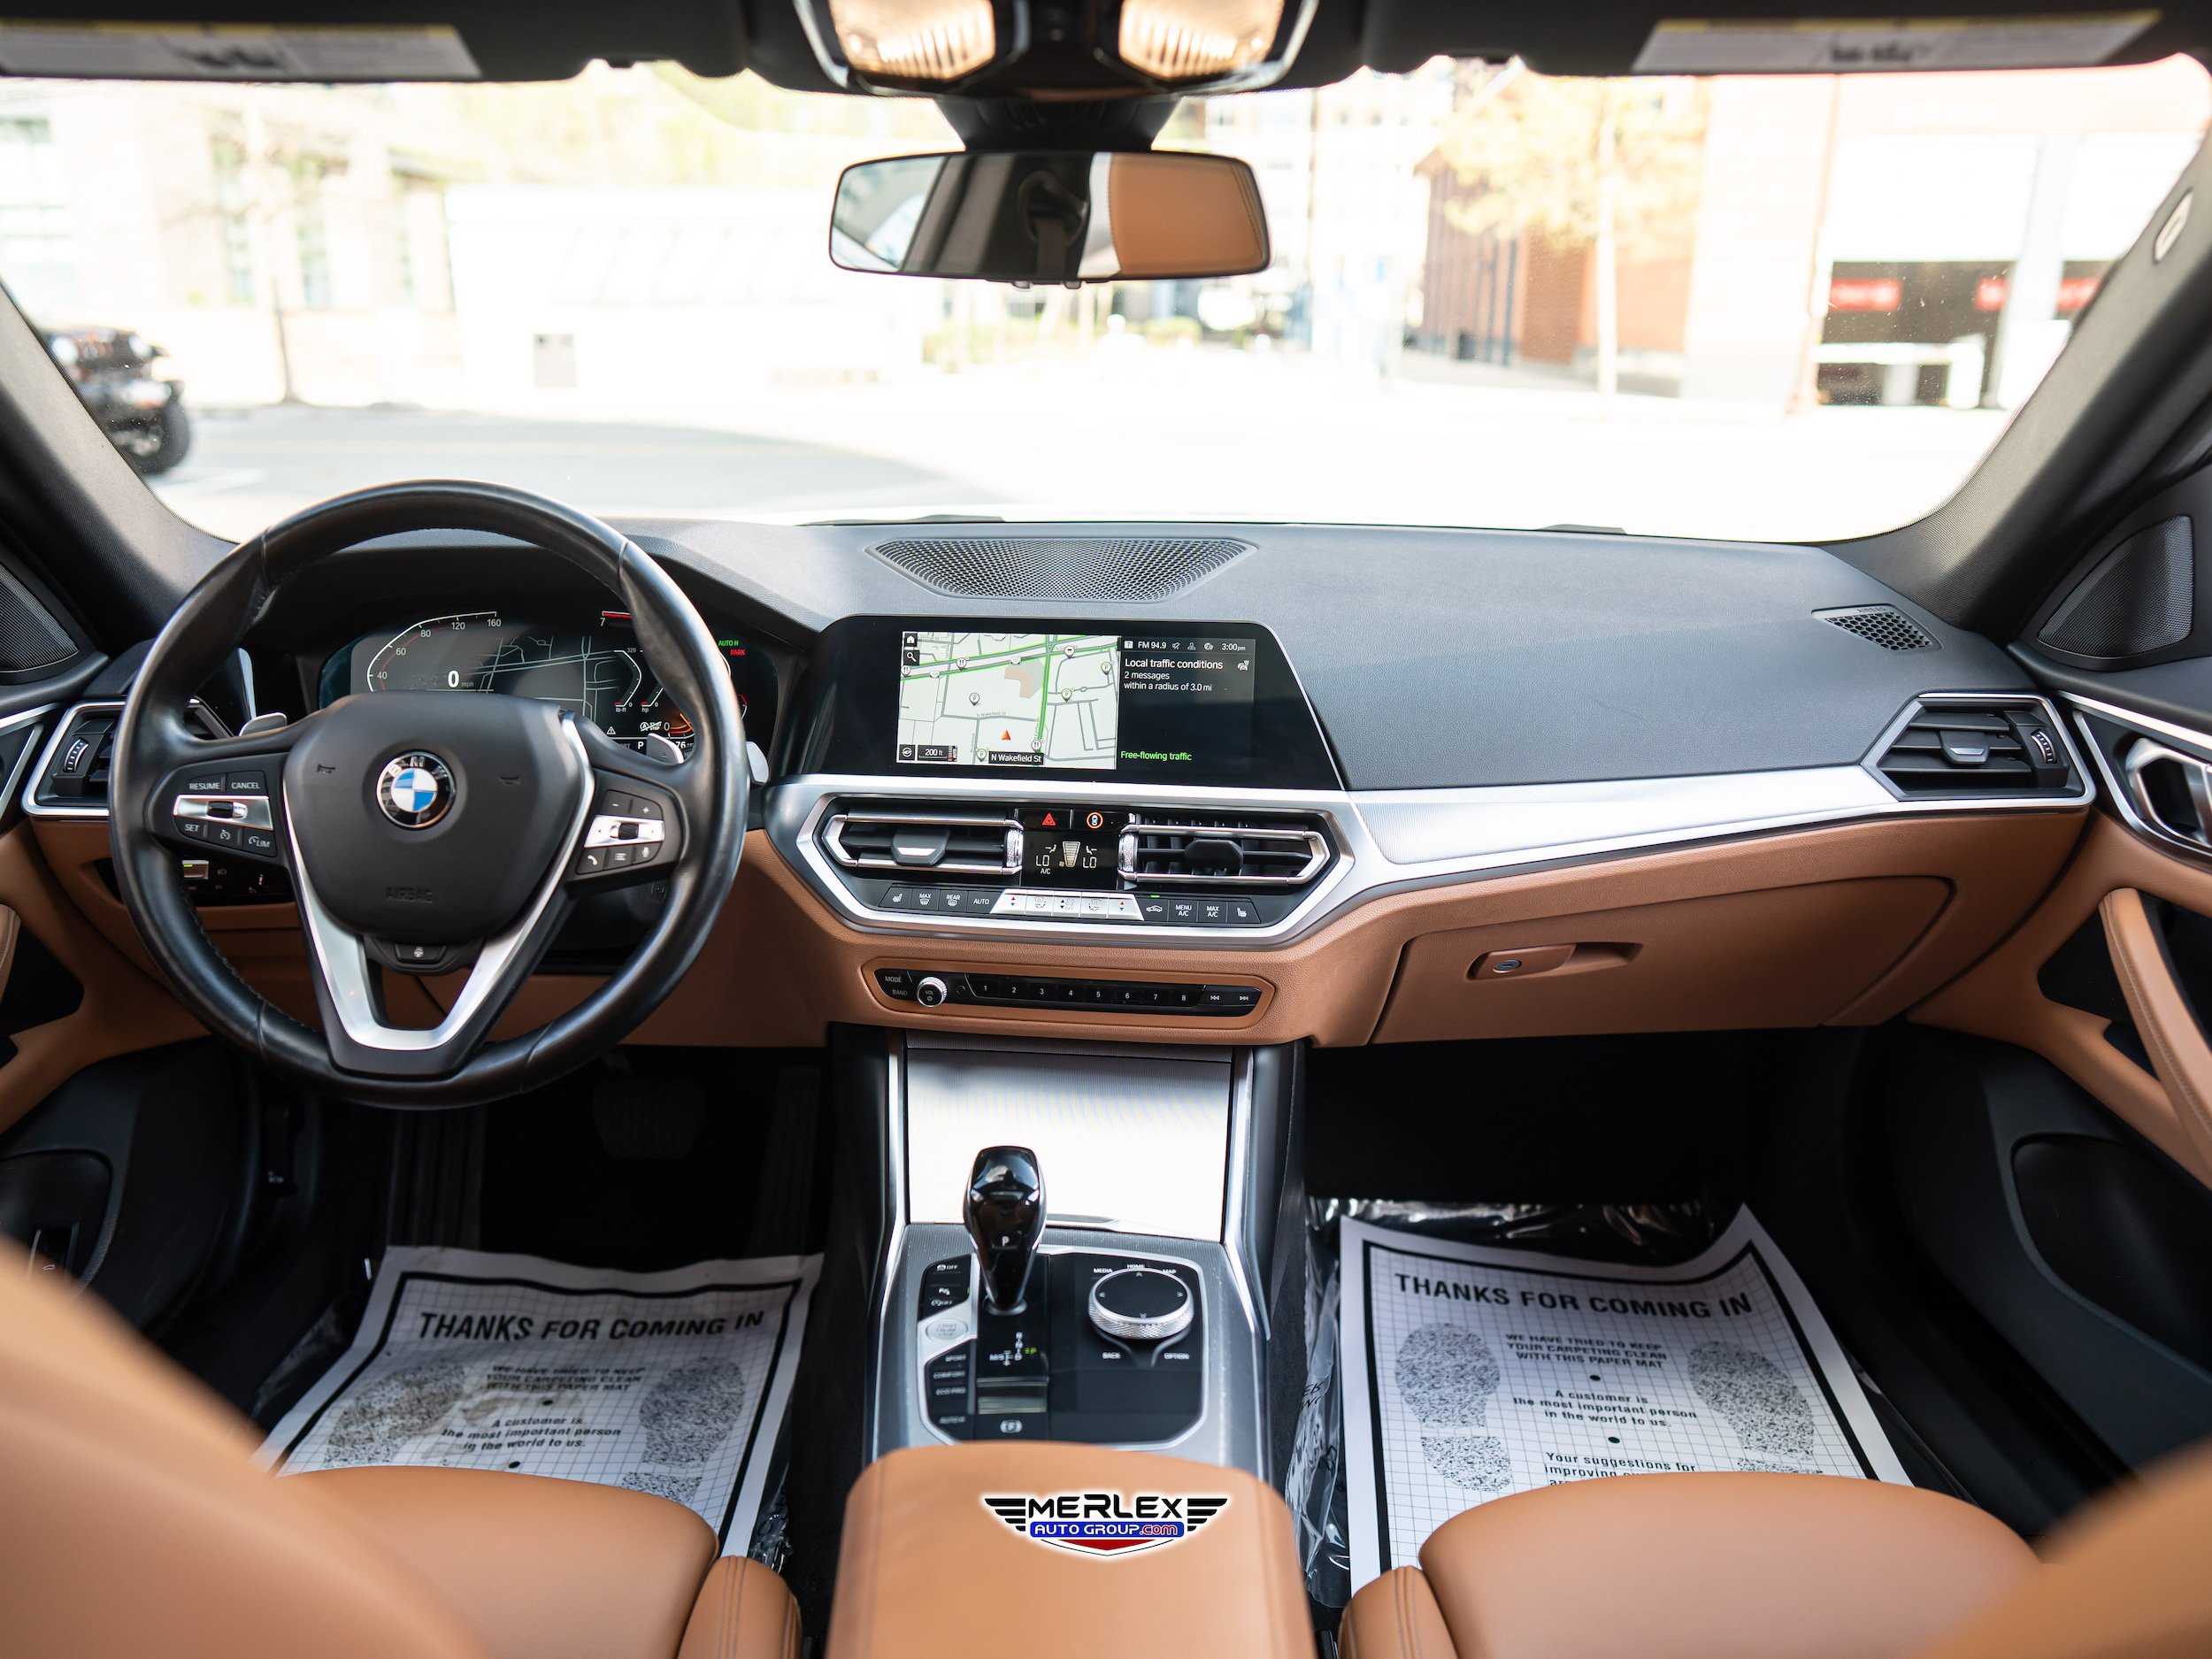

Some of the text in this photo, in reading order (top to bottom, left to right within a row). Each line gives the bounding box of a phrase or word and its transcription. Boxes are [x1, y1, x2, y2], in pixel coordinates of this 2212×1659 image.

[487, 618, 502, 627] 160
[599, 618, 606, 626] 7
[1125, 658, 1224, 669] Local traffic conditions
[448, 670, 460, 688] 0
[1131, 672, 1170, 681] messages
[1124, 681, 1147, 690] within
[996, 754, 1033, 763] Wakefield
[1120, 750, 1192, 761] Free-flowing traffic
[184, 823, 200, 832] SET
[1035, 855, 1050, 867] LO
[1082, 856, 1097, 869] LO
[1002, 1235, 1010, 1247] P
[1394, 1272, 1753, 1318] THANKS FOR COMING IN
[419, 1310, 765, 1342] THANKS FOR COMING IN
[1566, 1337, 1604, 1347] TRIED
[1629, 1342, 1662, 1351] KEEP
[1506, 1342, 1668, 1360] YOUR CARPETING CLEAN
[1516, 1351, 1663, 1369] WITH THIS PAPER MAT
[1555, 1389, 1648, 1404] A customer is
[1513, 1397, 1698, 1419] the most important person
[491, 1419, 501, 1428] A
[504, 1417, 566, 1426] customer
[1544, 1409, 1557, 1418] in
[1562, 1411, 1584, 1421] the
[1587, 1414, 1627, 1425] world
[1632, 1417, 1645, 1426] to
[442, 1427, 621, 1440] the most important person
[480, 1441, 503, 1451] the
[507, 1439, 544, 1448] world
[565, 1439, 586, 1448] us.
[1546, 1452, 1696, 1472] Your suggestions for
[1544, 1464, 1617, 1478] improving
